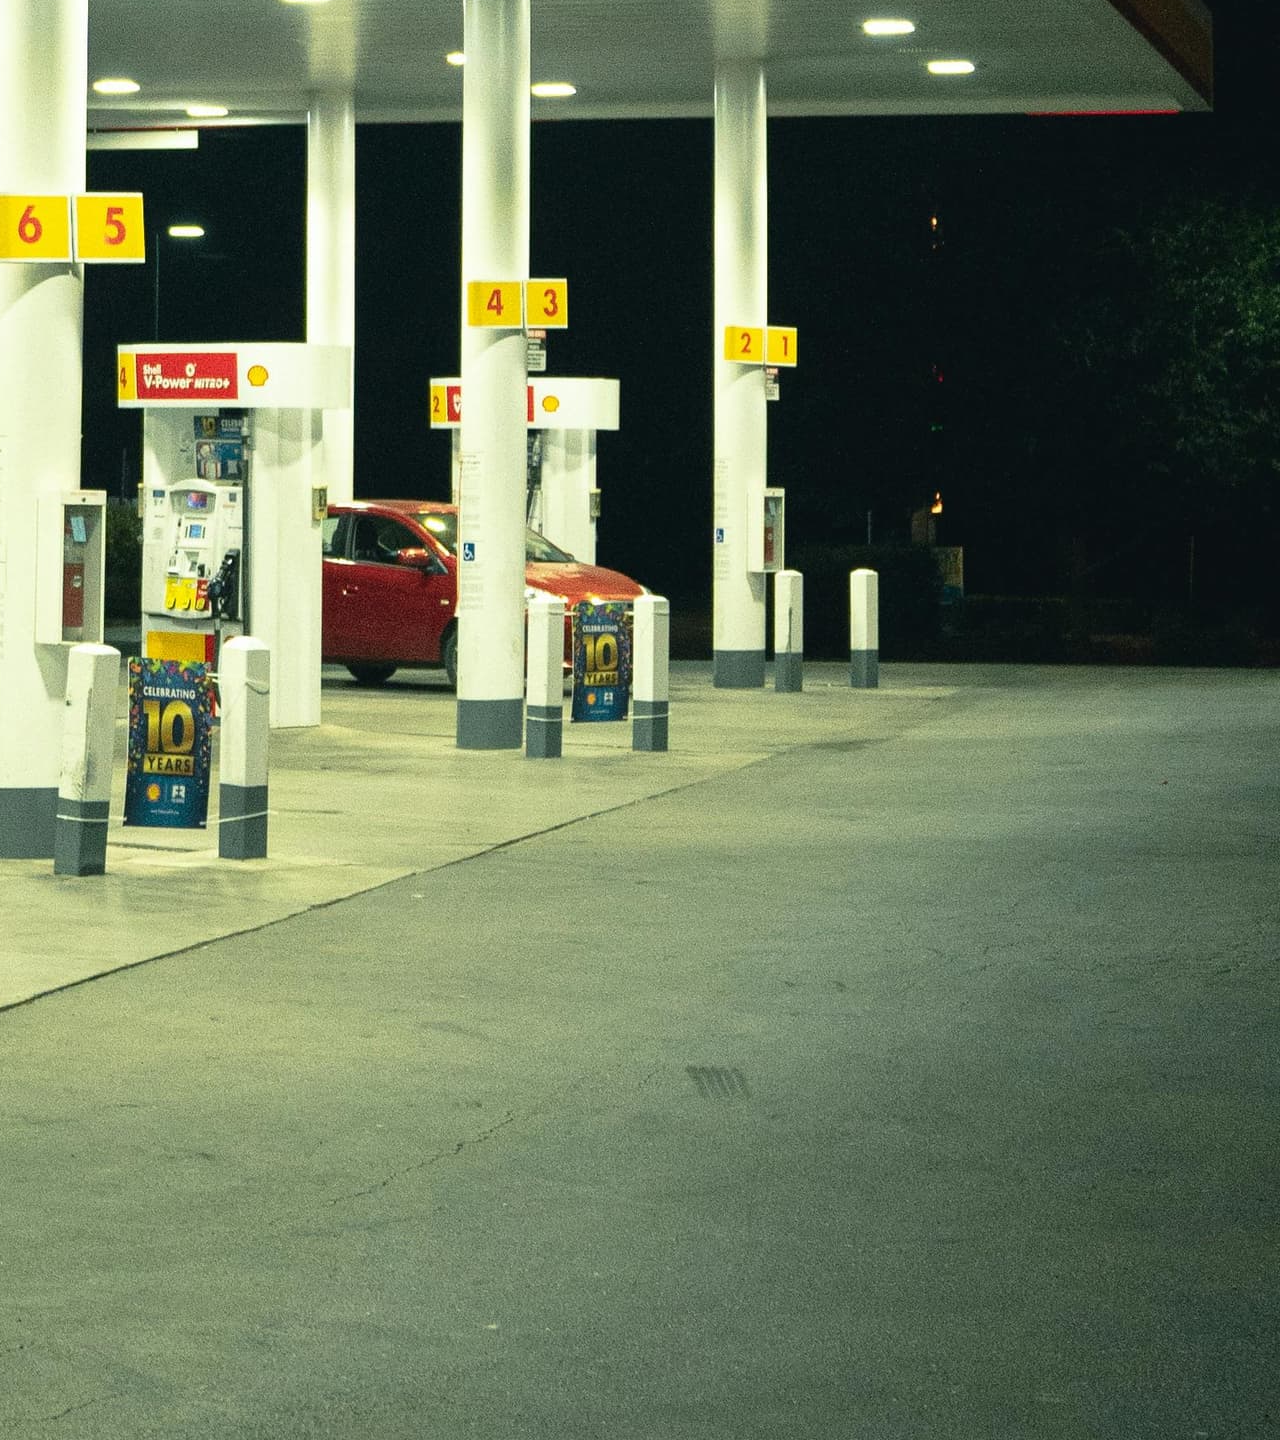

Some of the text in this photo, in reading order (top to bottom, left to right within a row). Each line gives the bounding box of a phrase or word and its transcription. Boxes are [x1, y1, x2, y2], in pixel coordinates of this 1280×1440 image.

[18, 205, 42, 244] 6
[105, 207, 126, 245] 5
[487, 288, 503, 316] 4
[543, 288, 558, 317] 3
[741, 332, 751, 353] 2
[782, 336, 788, 356] 1
[143, 375, 191, 389] V-Power
[433, 396, 440, 413] 2
[583, 633, 618, 672] 10
[143, 686, 196, 701] CELEBRATING
[143, 699, 195, 754] 10
[148, 756, 191, 773] YEARS
